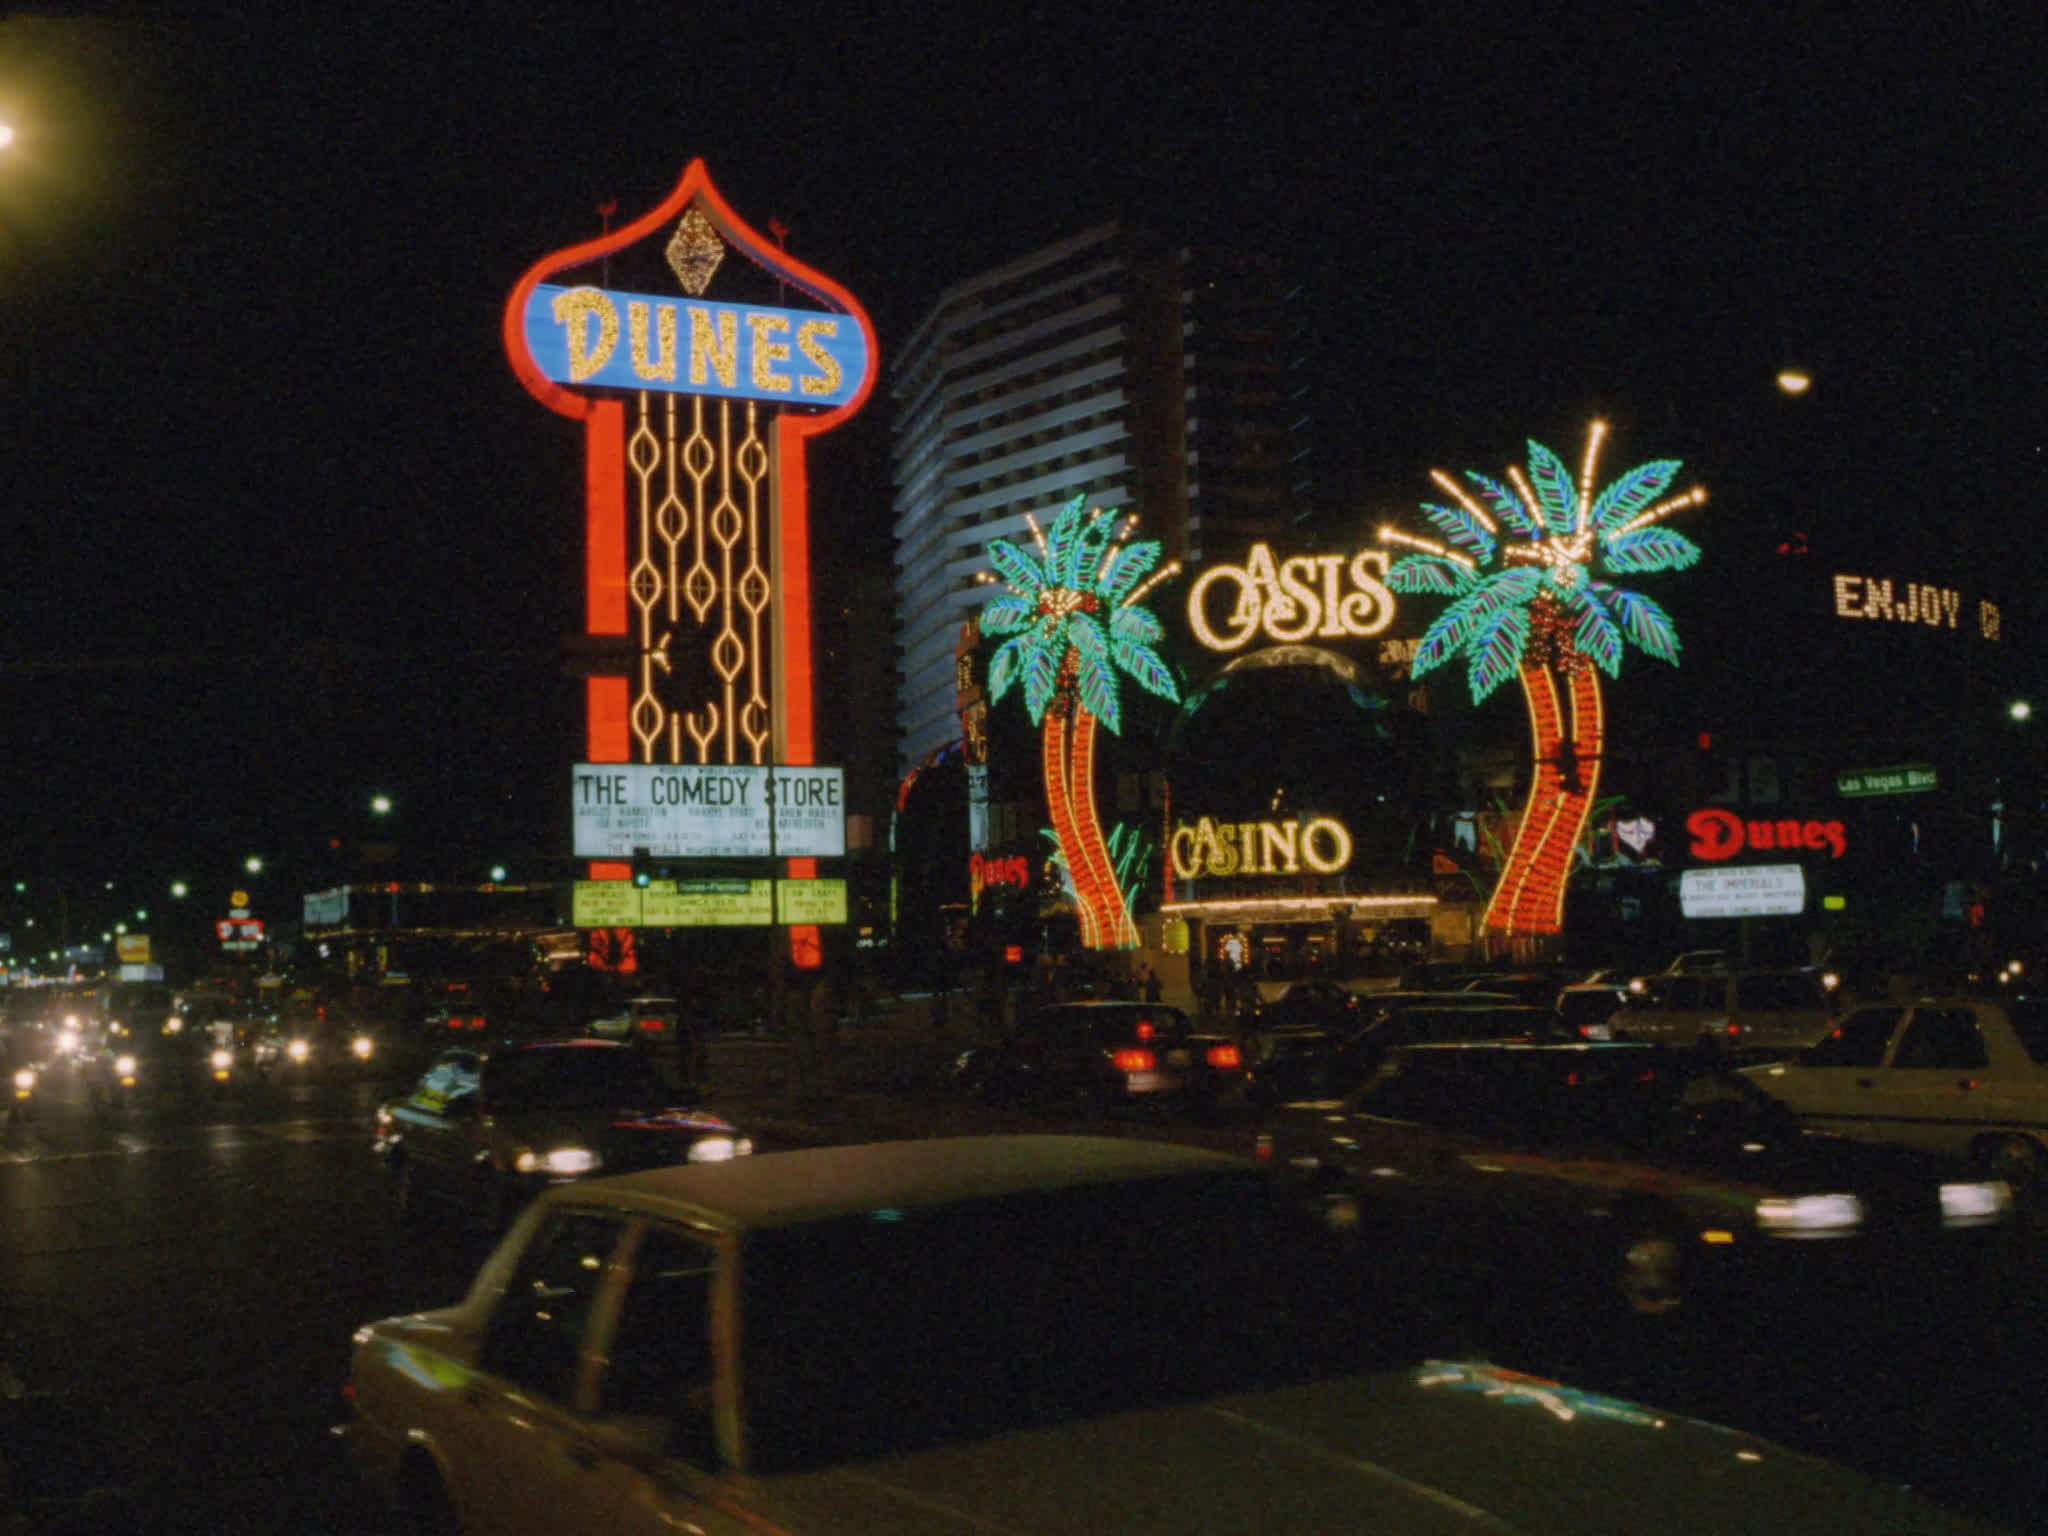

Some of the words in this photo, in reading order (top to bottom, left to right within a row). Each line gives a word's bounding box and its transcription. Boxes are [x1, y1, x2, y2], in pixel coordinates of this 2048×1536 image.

[551, 287, 842, 395] DUNES
[1188, 542, 1397, 652] OASIS
[1833, 574, 1961, 629] ENJOY
[578, 775, 628, 805] THE
[650, 776, 750, 807] COMEDY
[1839, 775, 1861, 793] Las
[1864, 774, 1903, 793] Vegas
[1171, 816, 1353, 880] CASINO
[1685, 807, 1847, 861] Dunes
